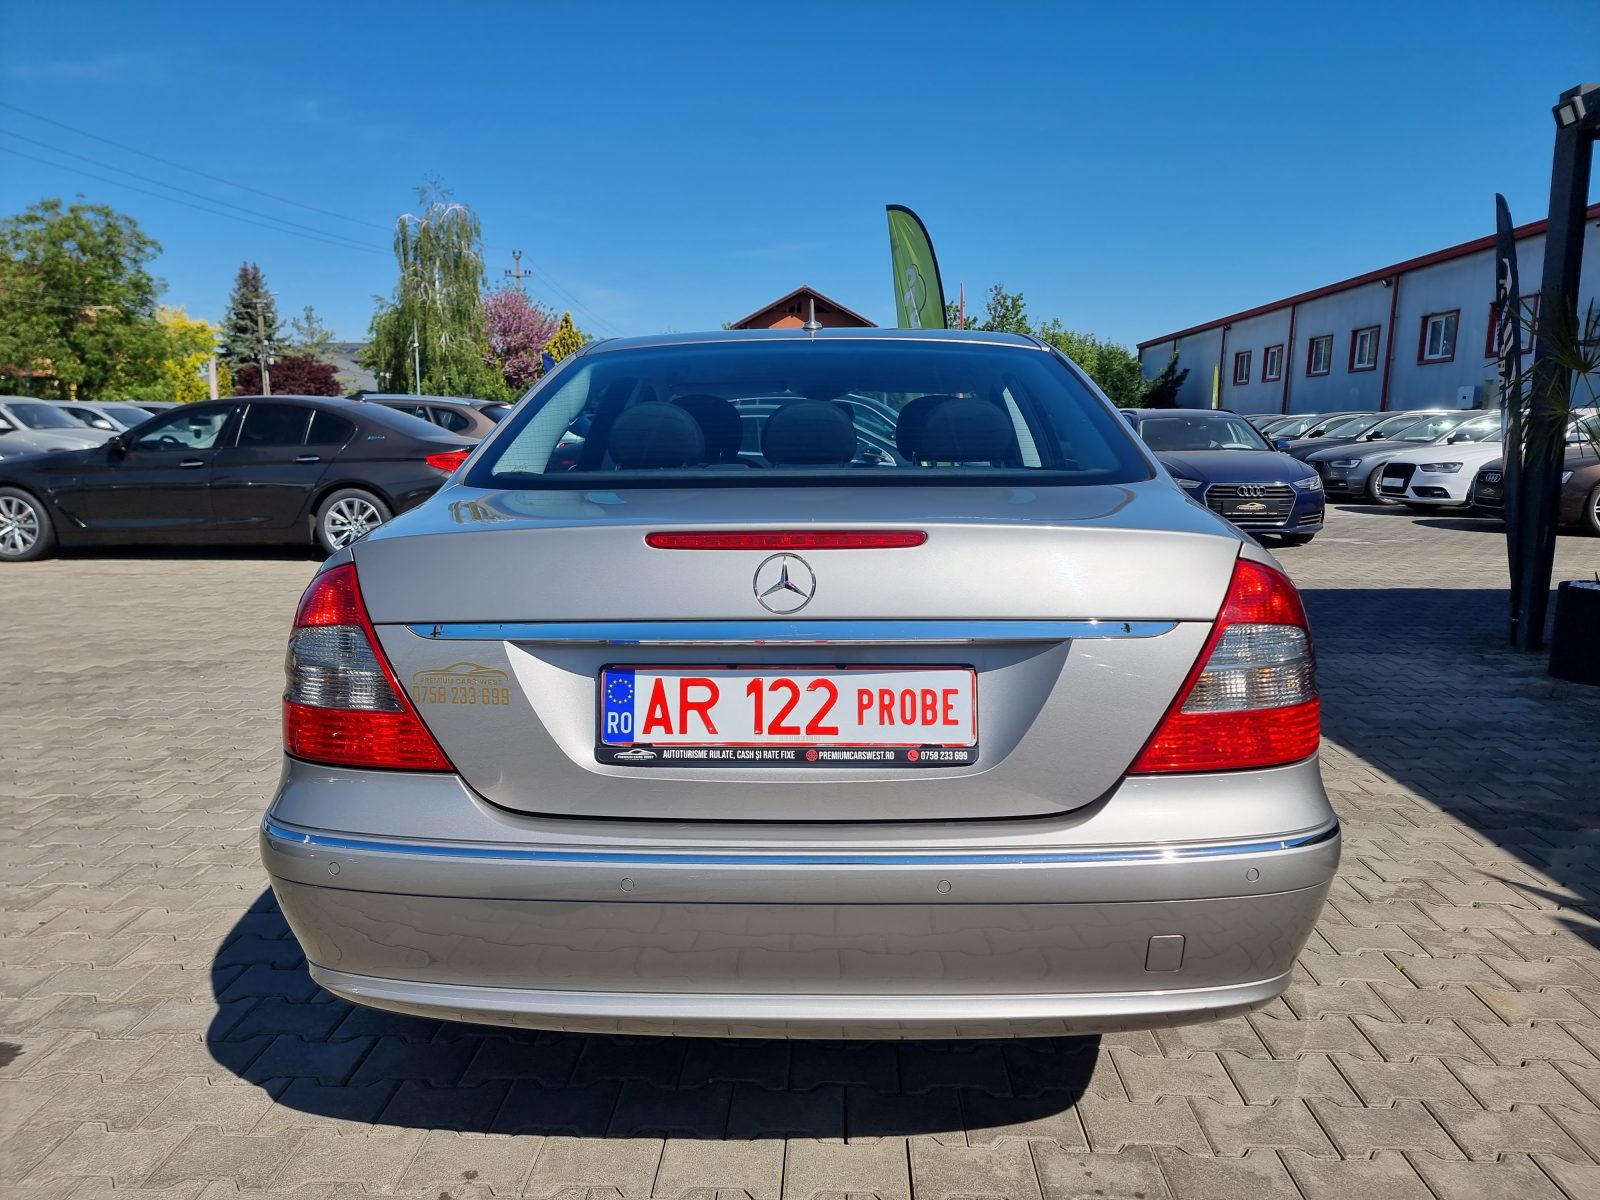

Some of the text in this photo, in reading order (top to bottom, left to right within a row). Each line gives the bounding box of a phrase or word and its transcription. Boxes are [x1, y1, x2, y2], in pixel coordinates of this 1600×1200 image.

[413, 686, 510, 706] 0758 233 699
[642, 677, 960, 736] AR 122 PROBE
[607, 711, 632, 734] RO
[663, 750, 708, 759] AUTOTURISME
[709, 750, 736, 760] RULATE,
[736, 750, 755, 759] CASH
[763, 750, 780, 759] RATE
[780, 750, 796, 760] FIXE
[818, 750, 895, 761] PREMIUMCARSWEST.RO
[920, 751, 968, 761] 0758 233 699
